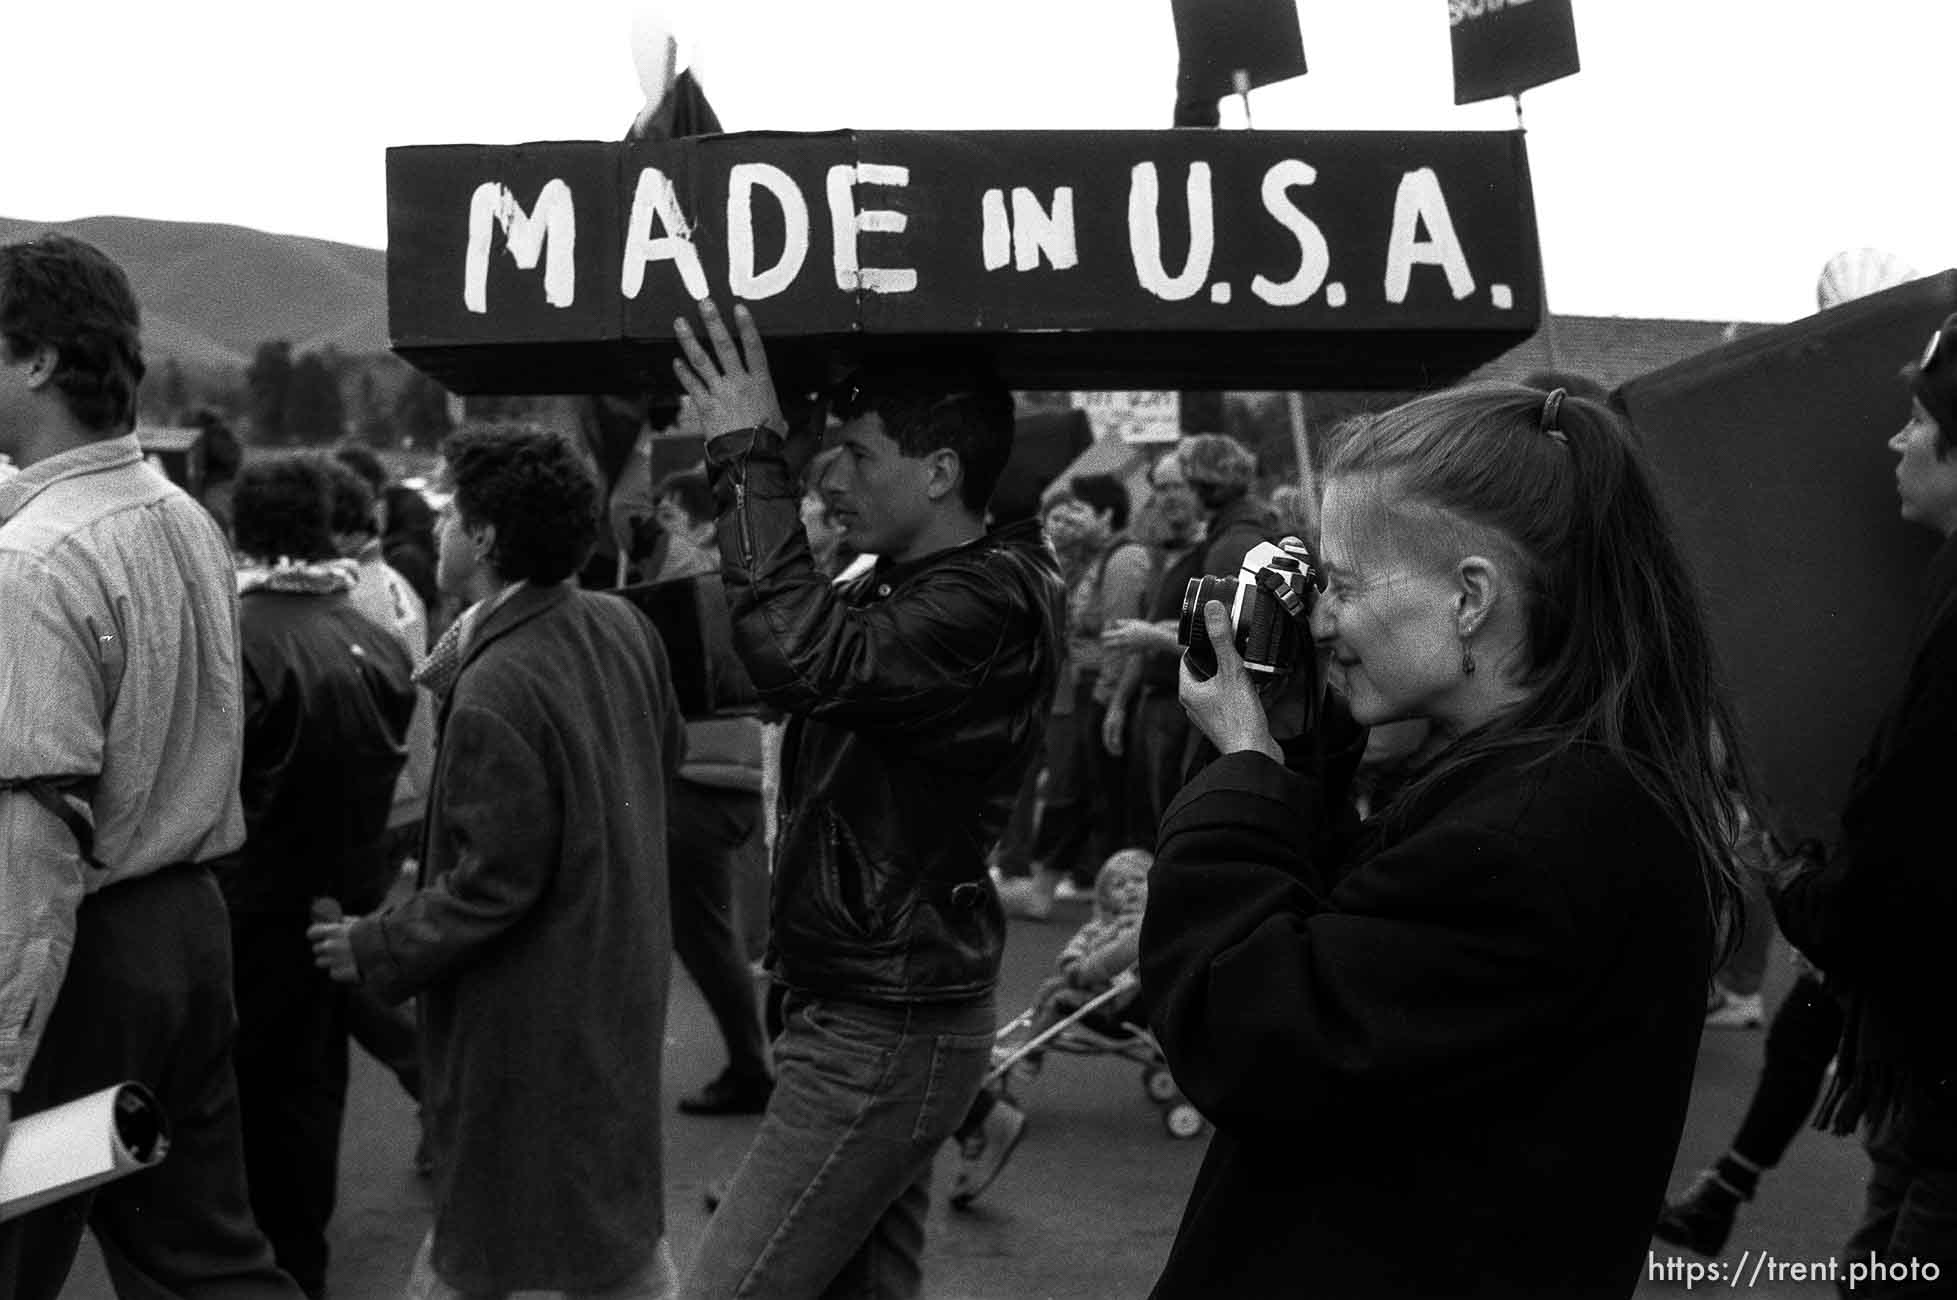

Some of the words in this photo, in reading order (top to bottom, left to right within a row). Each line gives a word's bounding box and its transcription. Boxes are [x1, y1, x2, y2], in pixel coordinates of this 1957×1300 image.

[463, 161, 918, 314] MADE
[982, 186, 1078, 272] IN
[1127, 159, 1515, 310] U.S.A.
